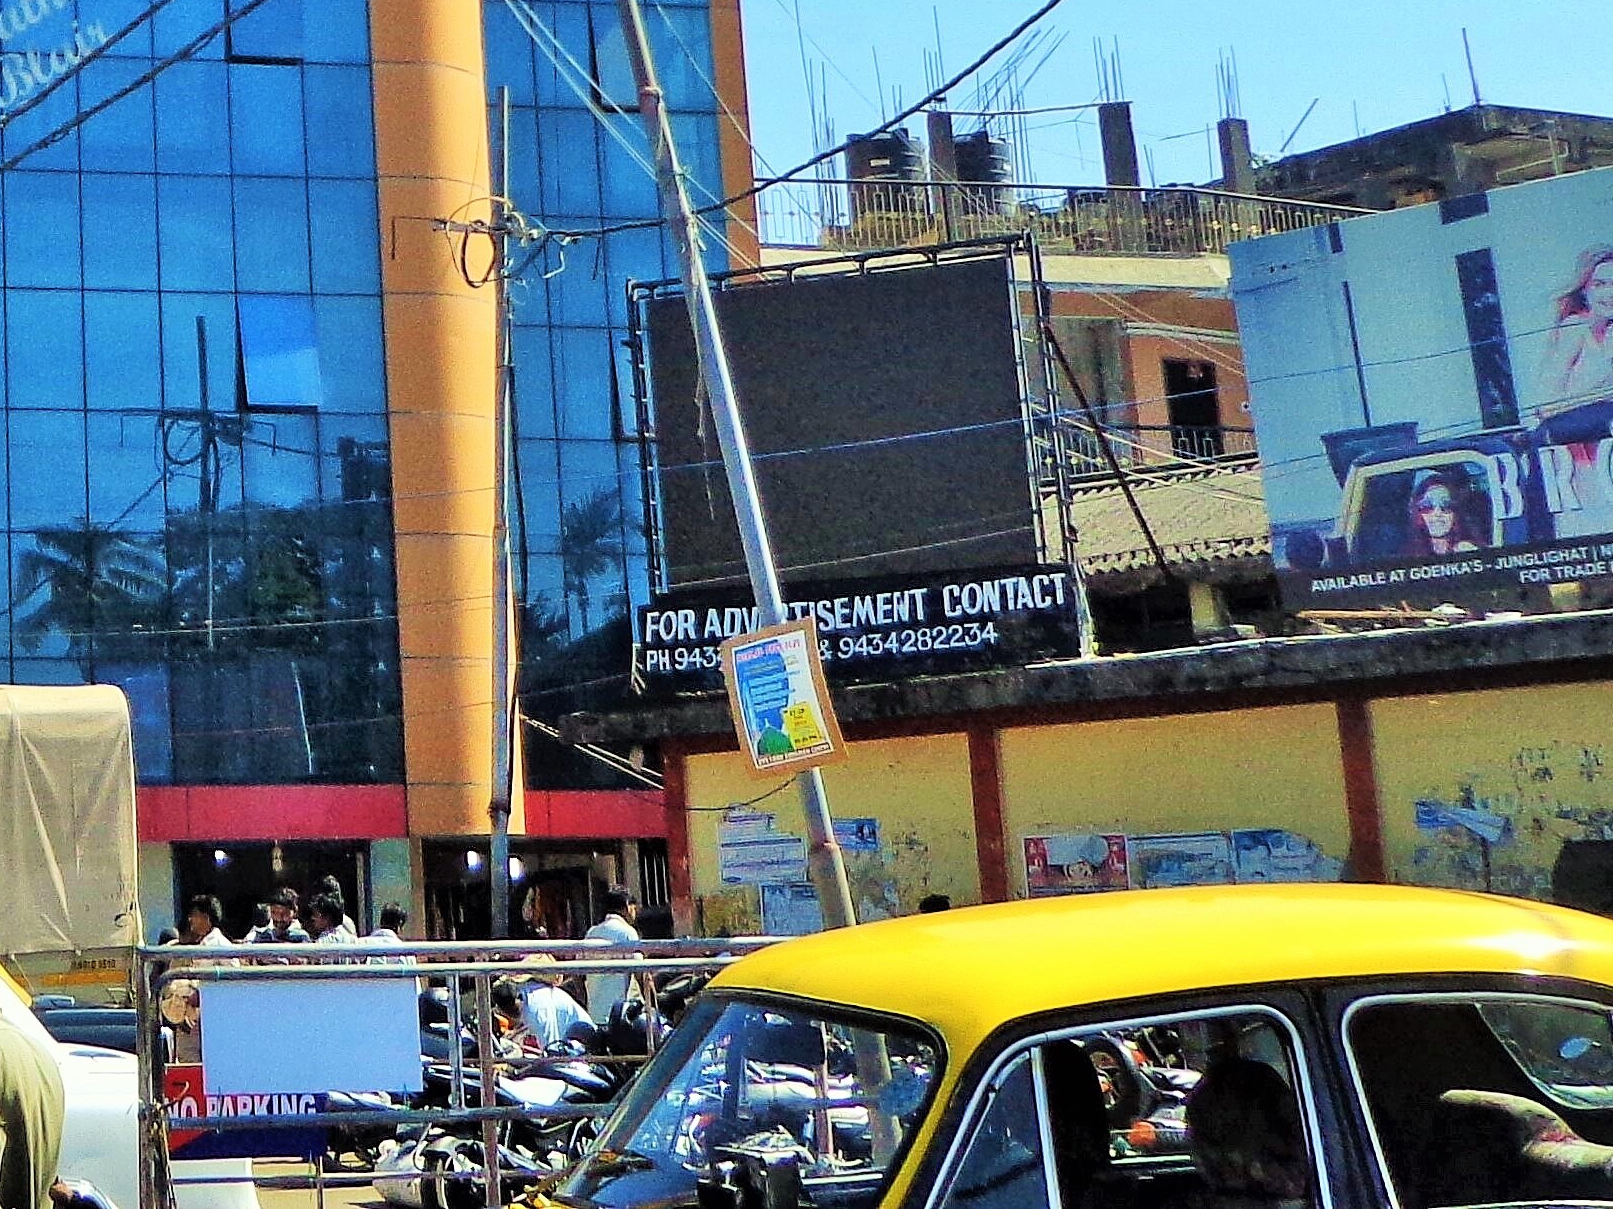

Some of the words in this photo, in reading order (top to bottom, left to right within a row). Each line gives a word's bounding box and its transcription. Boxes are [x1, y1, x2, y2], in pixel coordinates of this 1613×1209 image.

[1311, 571, 1386, 592] AVAILABLE
[1389, 569, 1406, 583] AT
[1410, 560, 1483, 580] GOENKA'S
[1519, 569, 1551, 584] FOR
[1553, 561, 1606, 579] TRADE
[645, 609, 696, 642] FOR
[704, 587, 928, 638] ADVTISEMENT
[943, 573, 1065, 618] CONTACT
[646, 648, 670, 672] PH
[819, 639, 832, 661] &
[838, 622, 998, 659] 9434282234
[206, 1093, 317, 1118] PARKING
